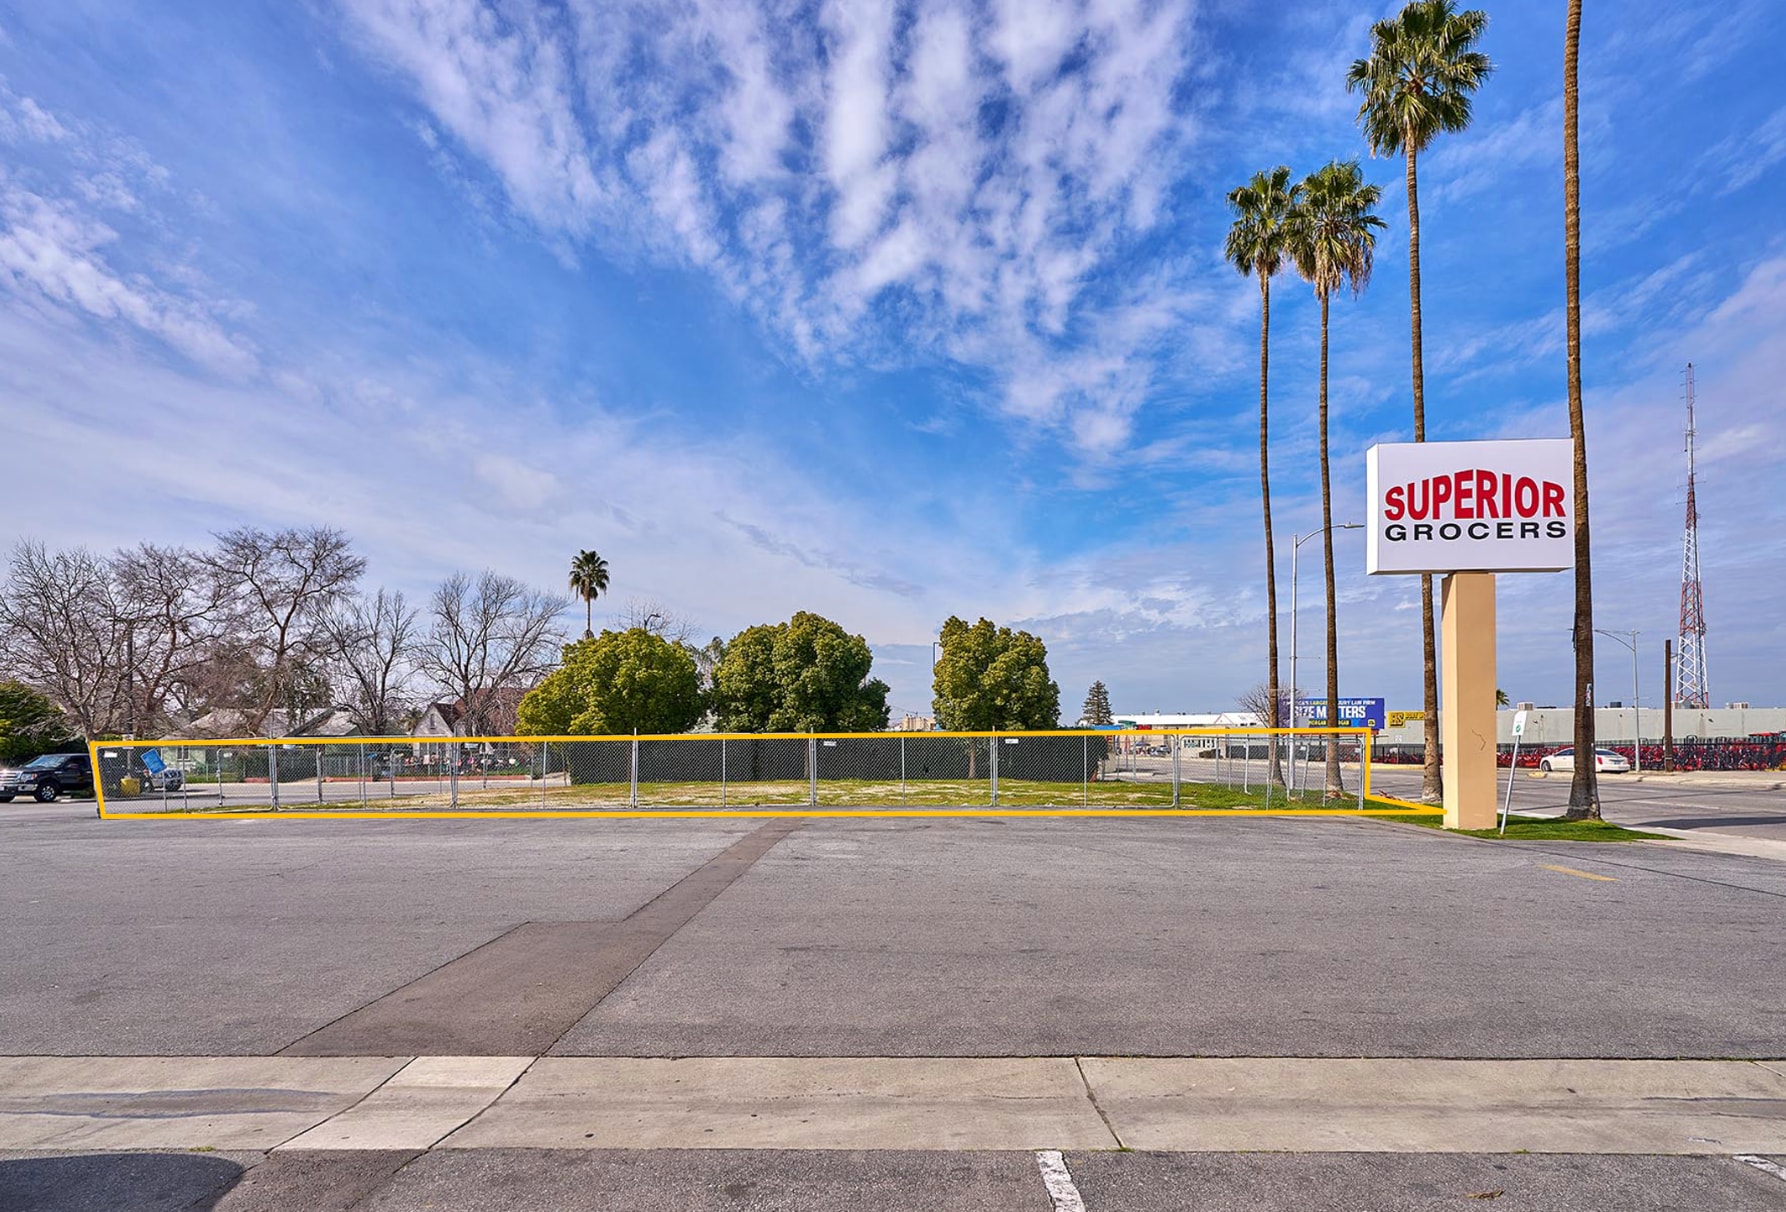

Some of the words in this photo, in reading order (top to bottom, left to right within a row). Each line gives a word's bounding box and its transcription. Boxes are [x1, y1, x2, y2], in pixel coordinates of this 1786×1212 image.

[1384, 469, 1566, 521] SUPERIOR
[1385, 521, 1566, 541] GROCERS
[1316, 706, 1366, 718] MTERS
